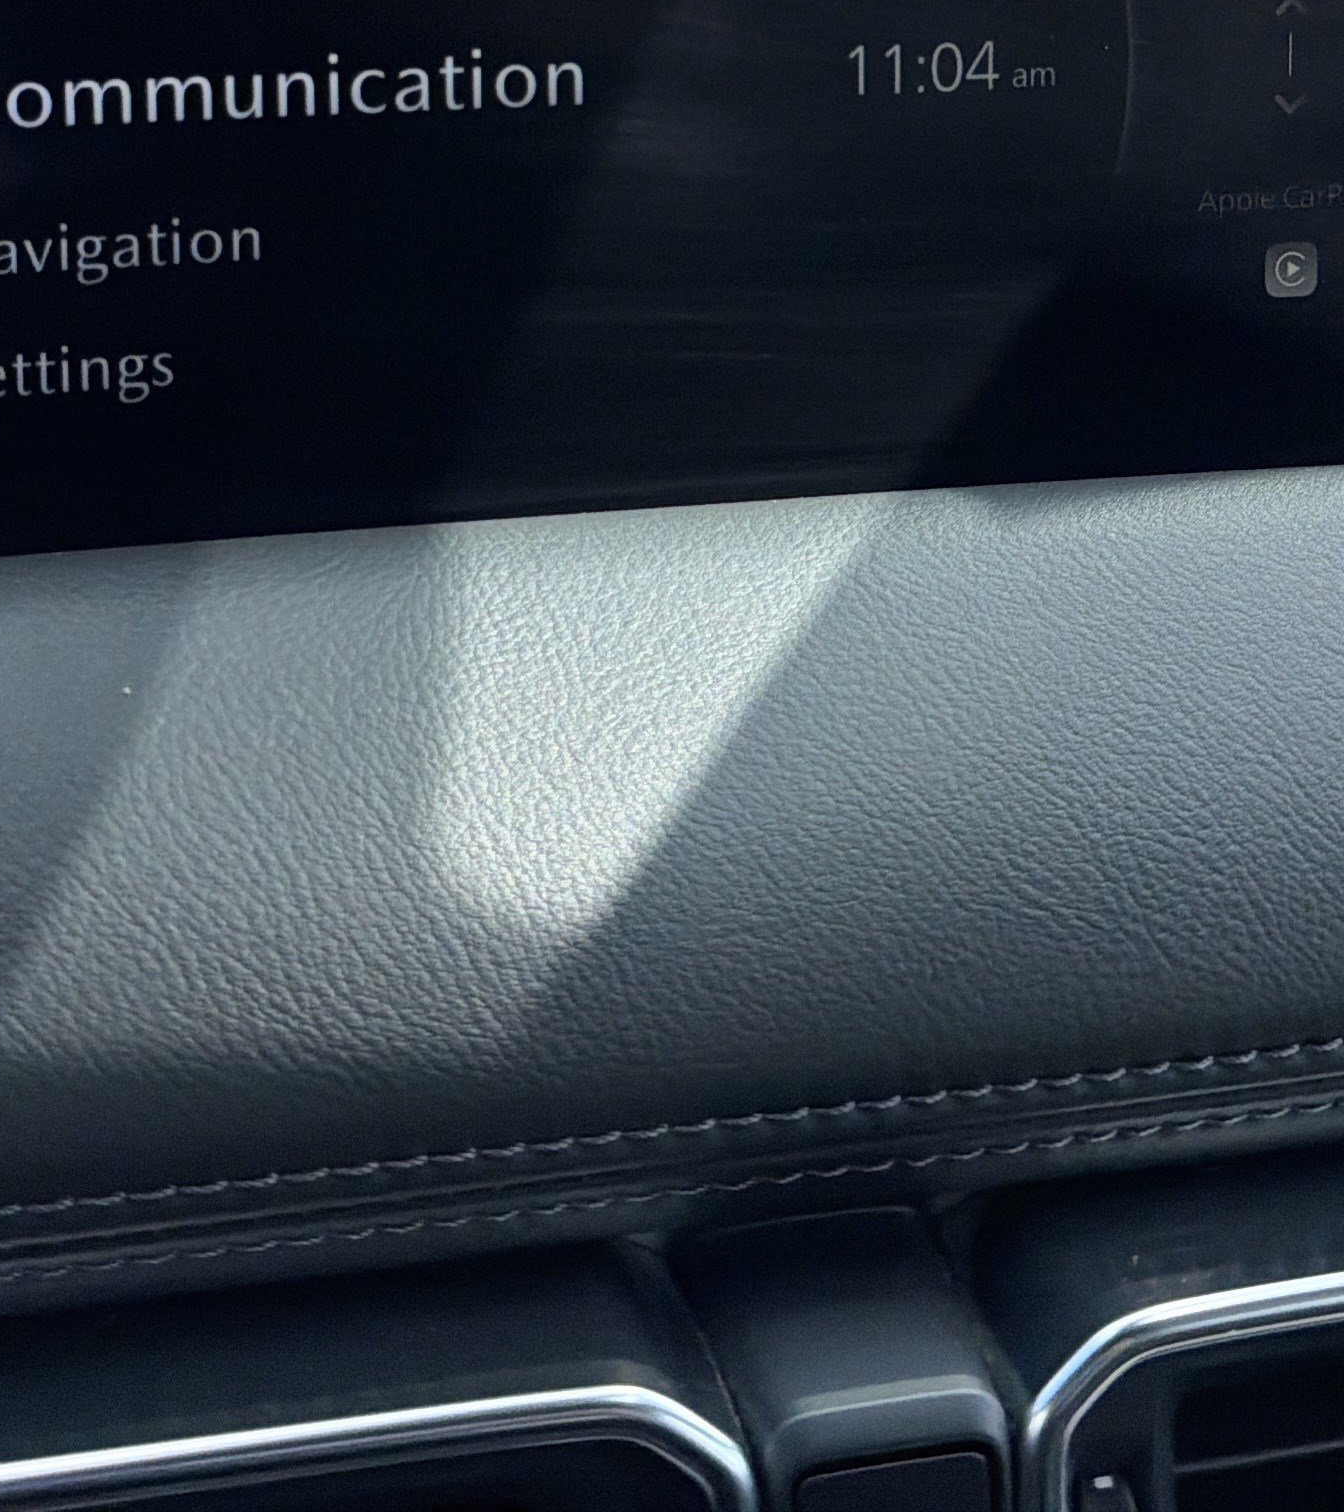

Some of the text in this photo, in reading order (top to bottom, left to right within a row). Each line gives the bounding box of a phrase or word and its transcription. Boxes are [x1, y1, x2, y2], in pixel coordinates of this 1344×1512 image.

[849, 40, 1056, 96] 11:04 am
[1197, 189, 1276, 219] Apple
